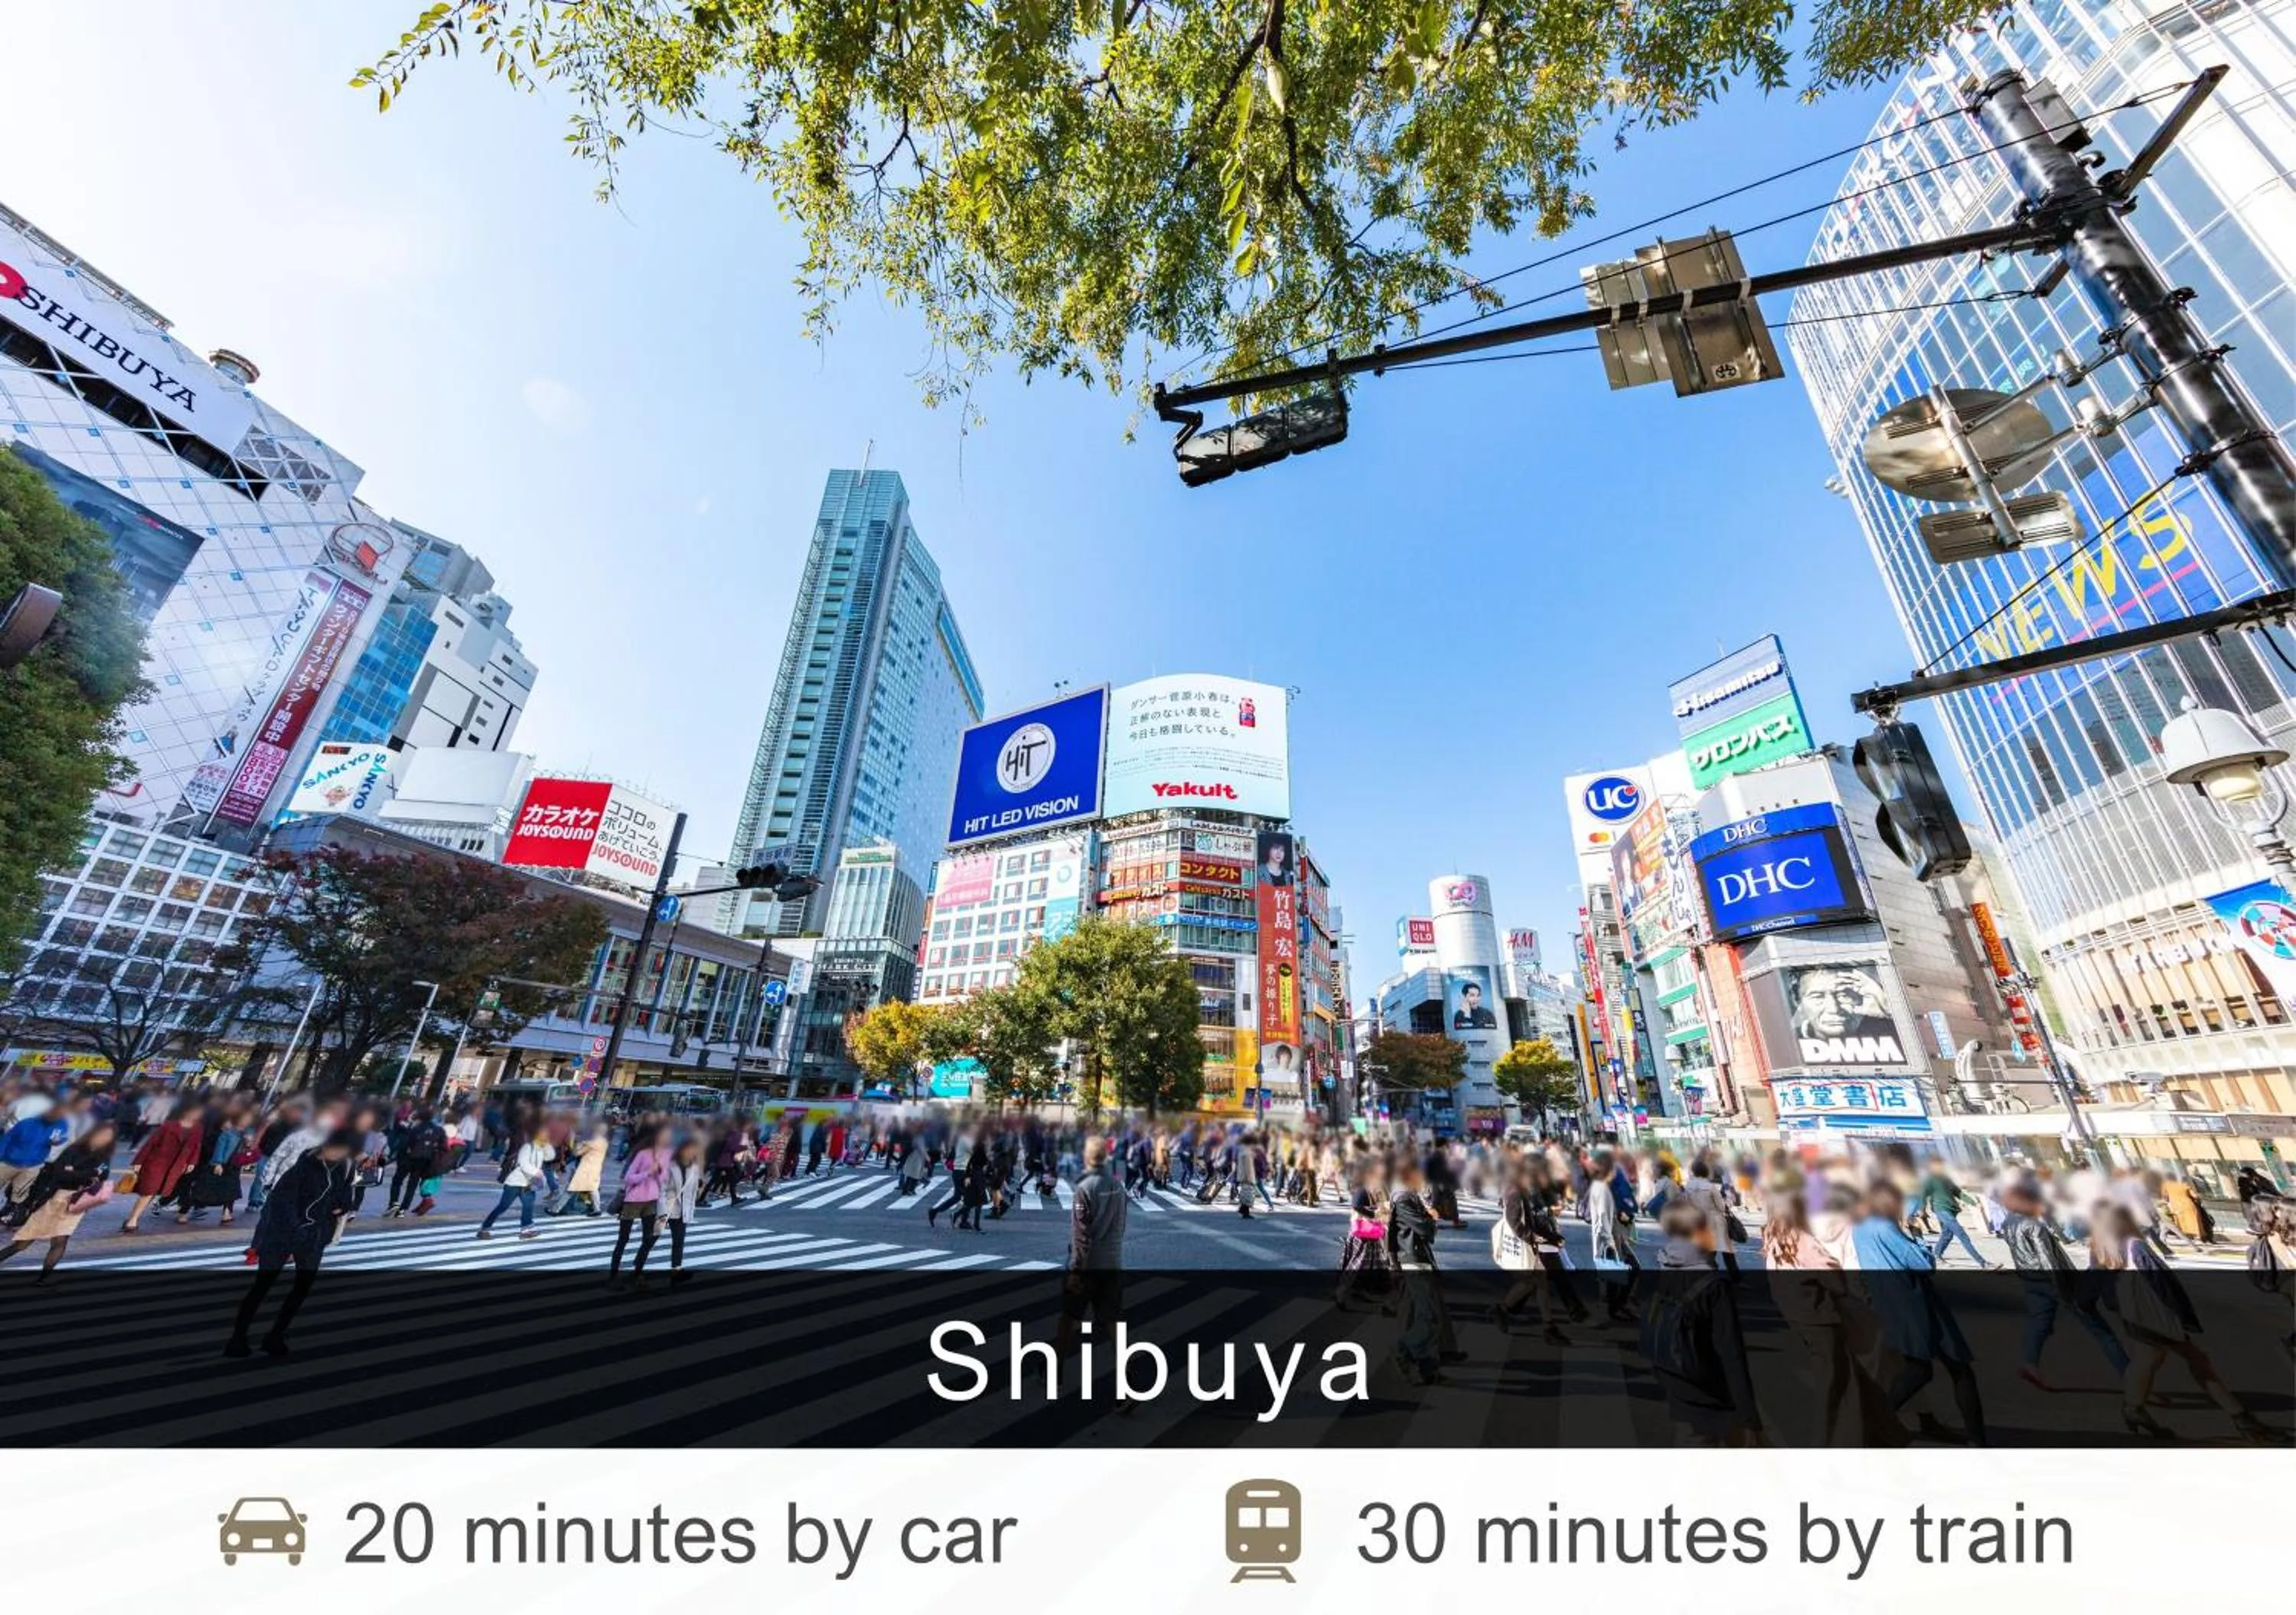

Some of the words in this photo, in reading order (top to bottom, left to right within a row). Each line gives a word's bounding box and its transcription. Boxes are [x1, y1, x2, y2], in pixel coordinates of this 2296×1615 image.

[13, 285, 197, 413] SHIBUYA
[1975, 481, 2192, 661] NEWS
[1691, 714, 1796, 772] サロンパス
[302, 753, 369, 788] SANKYO
[354, 753, 386, 809] SANKYO
[1152, 781, 1238, 799] Yakult
[1587, 785, 1636, 811] UC
[523, 804, 600, 827] カラオケ
[607, 800, 656, 830] ココロの
[964, 816, 989, 834] HIT
[992, 808, 1022, 827] LED
[1025, 795, 1078, 821] VISION
[517, 824, 595, 840] JOYSOUND
[1723, 818, 1768, 842] DHC
[592, 843, 657, 876] JOYSOUND
[1181, 862, 1239, 879] コンタクト
[1222, 888, 1250, 899] ガスト
[1717, 857, 1815, 906] DHC
[1799, 1036, 1907, 1063] DMM
[1779, 1084, 1907, 1108] 大盛堂書店
